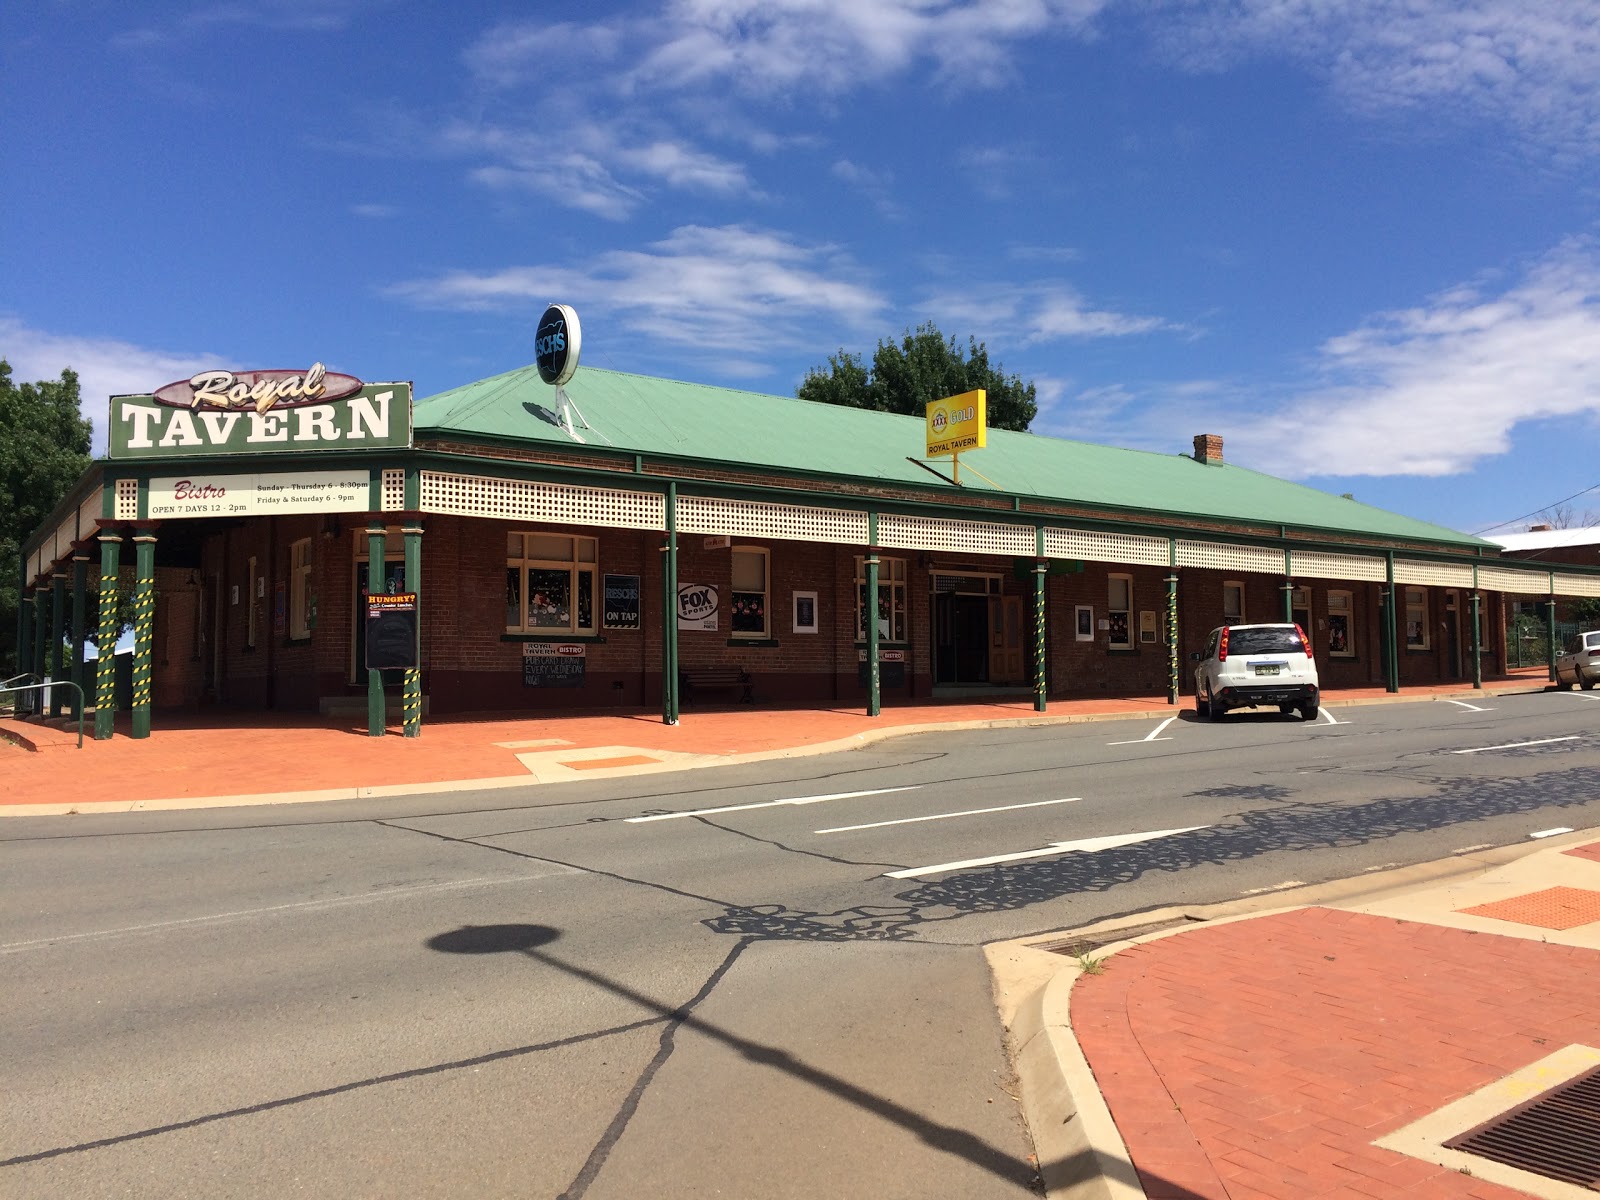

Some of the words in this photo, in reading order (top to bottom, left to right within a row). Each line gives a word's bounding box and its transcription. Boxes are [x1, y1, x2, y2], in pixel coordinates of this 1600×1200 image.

[189, 362, 327, 417] Royal
[121, 390, 394, 449] TAVERN
[950, 406, 975, 425] GOLD
[929, 443, 950, 454] ROYAL
[951, 437, 977, 449] TAVERN
[174, 480, 226, 500] Bistro
[257, 484, 285, 492] Sunday
[291, 483, 326, 491] Thursday
[340, 481, 368, 489] 8:30pm
[229, 504, 247, 512] 2pm
[368, 594, 416, 603] HUNGRY?
[605, 587, 638, 599] RESCHS
[679, 588, 713, 611] FOX
[606, 611, 620, 620] ON
[621, 612, 638, 621] TAP
[682, 604, 714, 616] SPORTS
